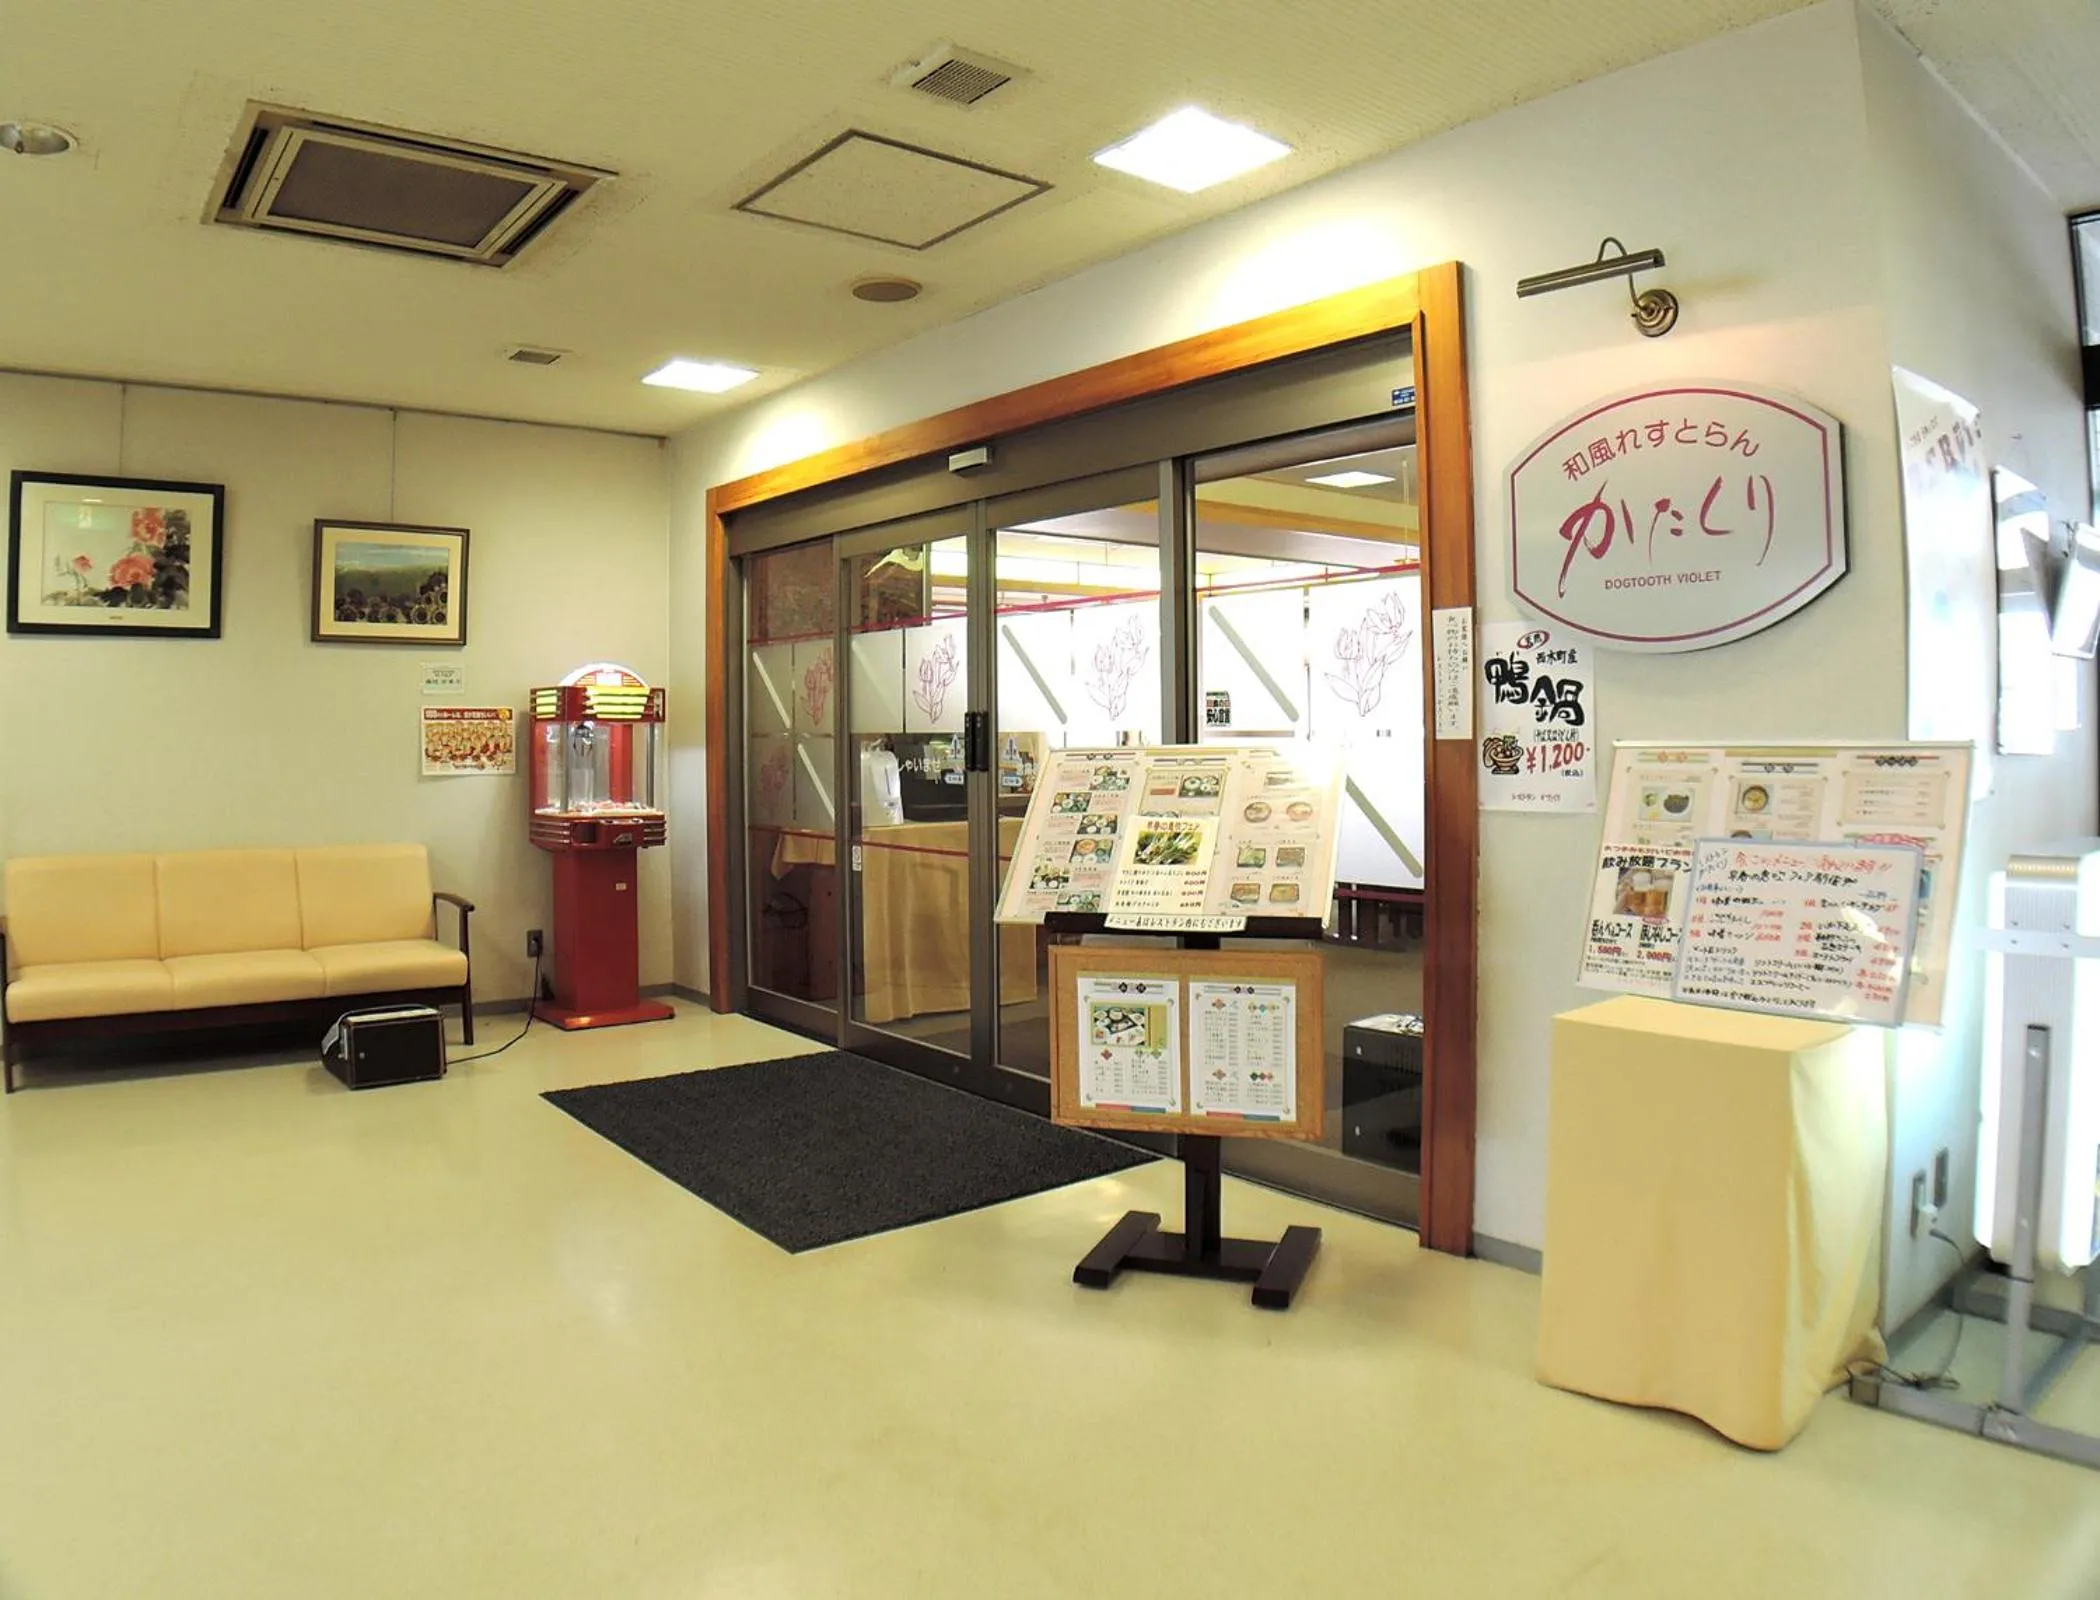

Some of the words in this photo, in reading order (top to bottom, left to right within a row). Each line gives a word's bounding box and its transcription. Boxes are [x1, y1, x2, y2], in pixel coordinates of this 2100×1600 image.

[1562, 418, 1759, 481] 和風れすとらん
[1558, 475, 1774, 598] かたくり
[1604, 575, 1672, 590] DOGTOOTH
[1677, 571, 1722, 584] VIOLET
[1602, 855, 1692, 873] 飲み放題プラン
